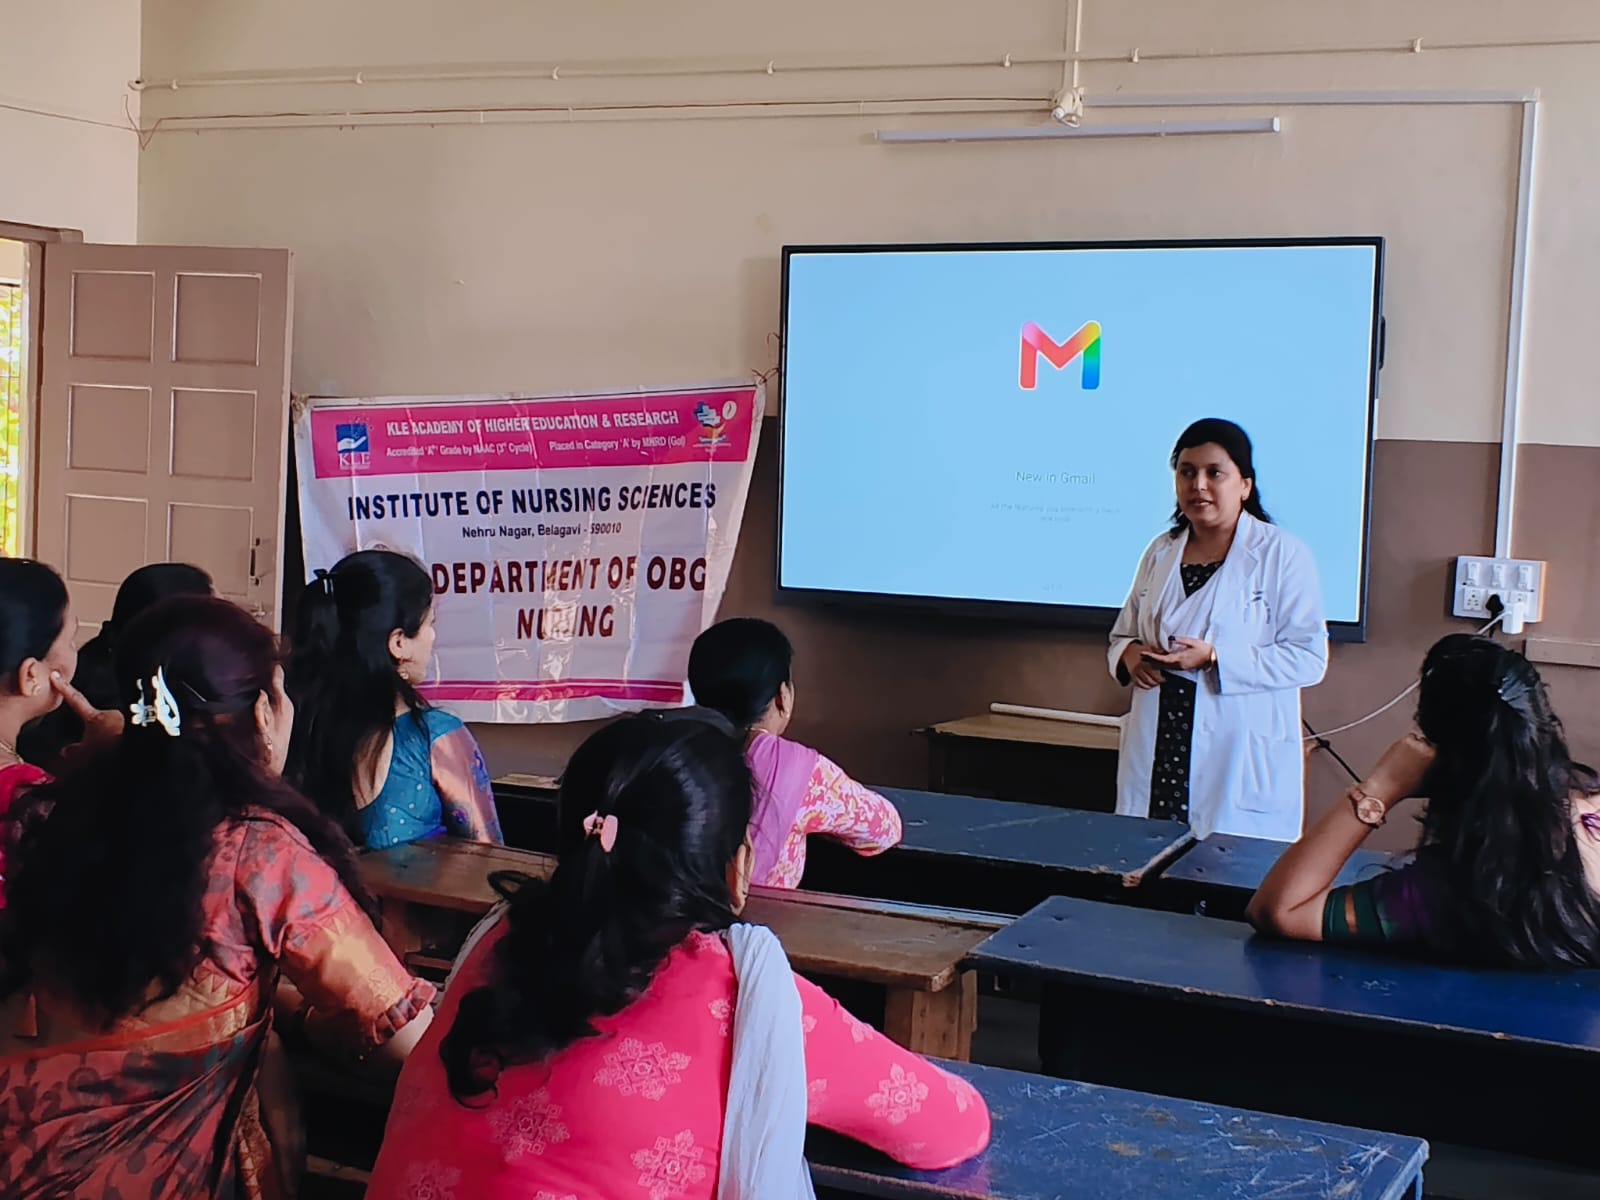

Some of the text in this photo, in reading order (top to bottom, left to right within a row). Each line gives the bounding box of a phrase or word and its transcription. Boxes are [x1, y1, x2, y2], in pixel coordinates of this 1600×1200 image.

[386, 410, 680, 437] KLE ACADEMY OF HIGHER EDUCATION & RESEARCH
[386, 446, 424, 457] Accredited
[440, 444, 461, 456] Grade
[462, 444, 472, 457] by
[549, 439, 575, 451] Placed
[575, 439, 584, 450] in
[584, 439, 619, 452] Category
[632, 436, 641, 450] by
[339, 451, 371, 465] KLE
[1016, 471, 1096, 485] New in Gmail
[348, 482, 717, 521] INSTITUTE OF NURSING SCIENCES
[462, 526, 496, 539] Nehru
[499, 525, 535, 540] Nagar,
[538, 523, 581, 539] Belagavi
[590, 521, 622, 535] 590010
[431, 555, 707, 594] DEPARTMENT OF OBG
